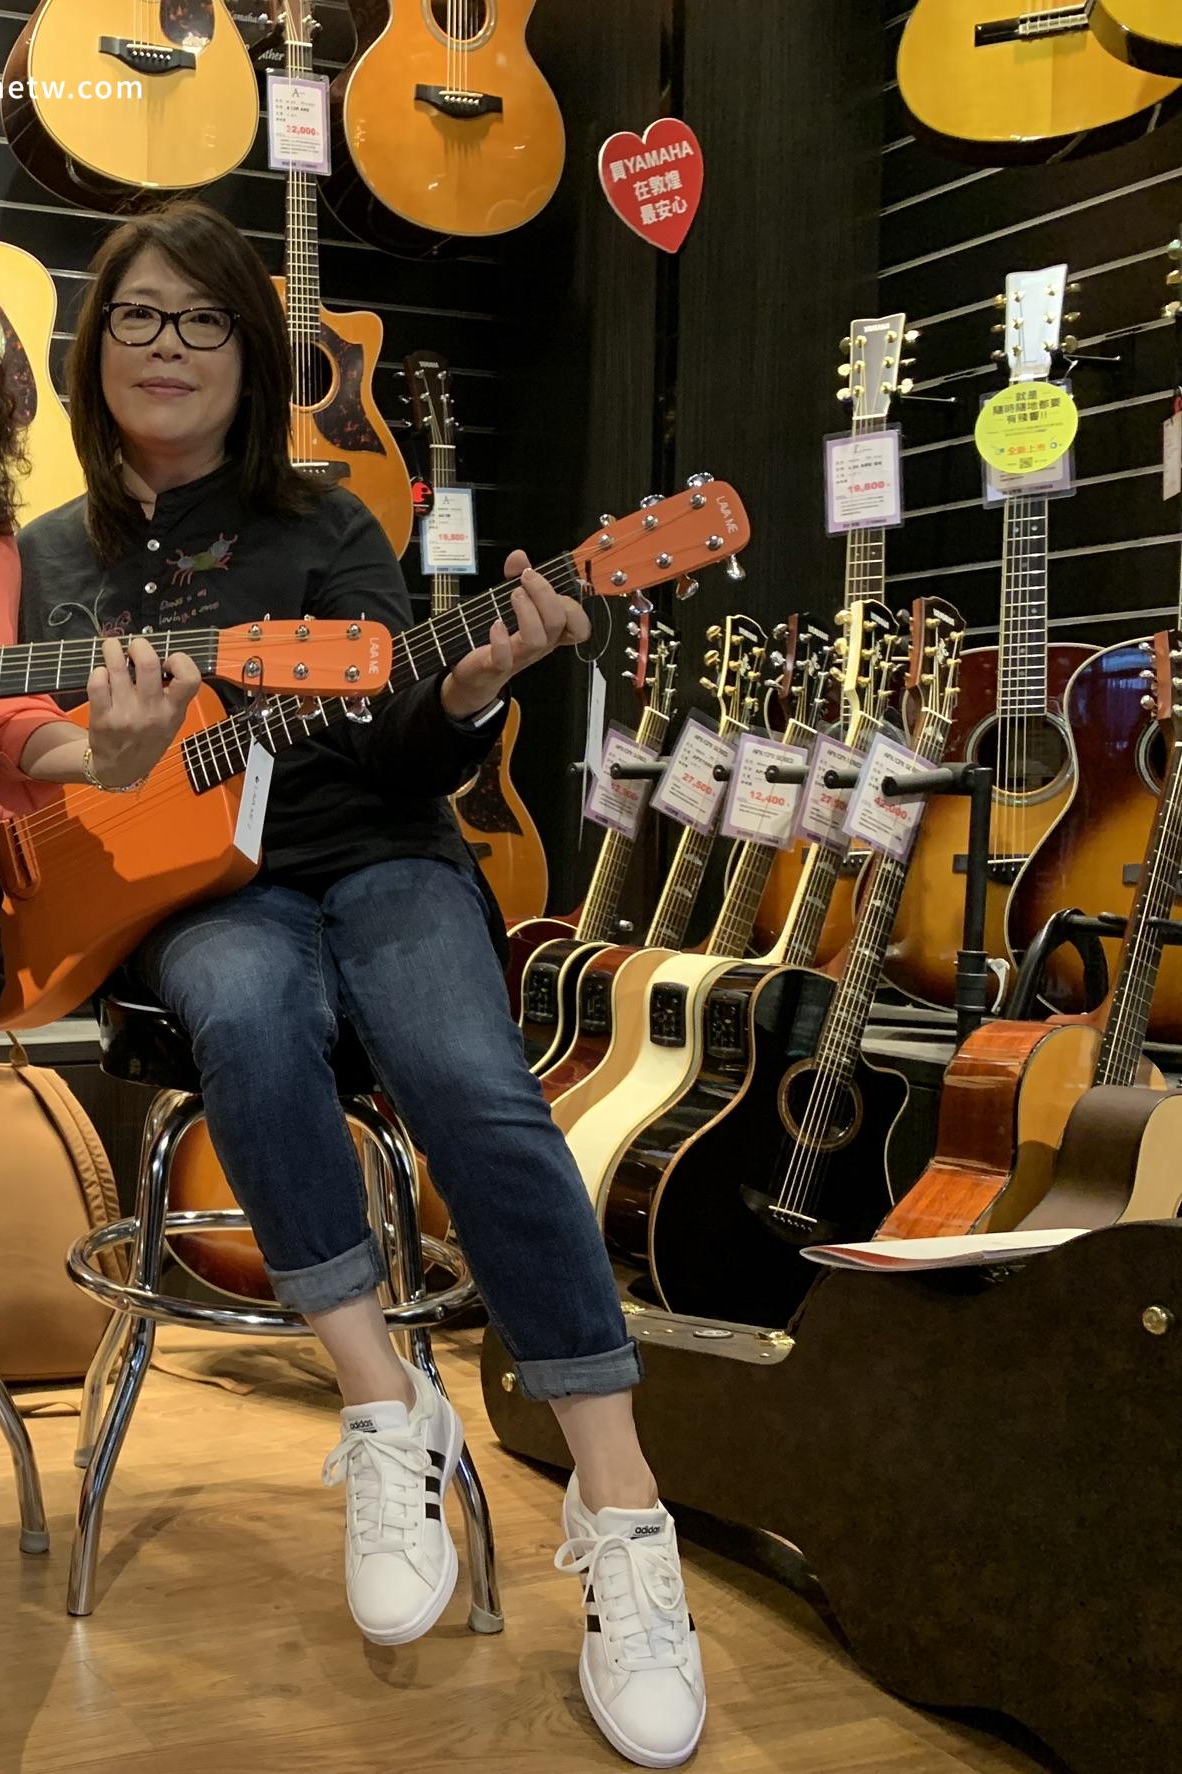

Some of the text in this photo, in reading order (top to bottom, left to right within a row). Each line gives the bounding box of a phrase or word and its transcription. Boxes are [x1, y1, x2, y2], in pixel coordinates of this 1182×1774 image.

[609, 140, 694, 183] 買YAMAHA
[633, 170, 683, 202] 在敦煌
[639, 195, 688, 226] 最安心
[349, 1418, 374, 1430] adidas
[634, 1525, 661, 1535] adidas
